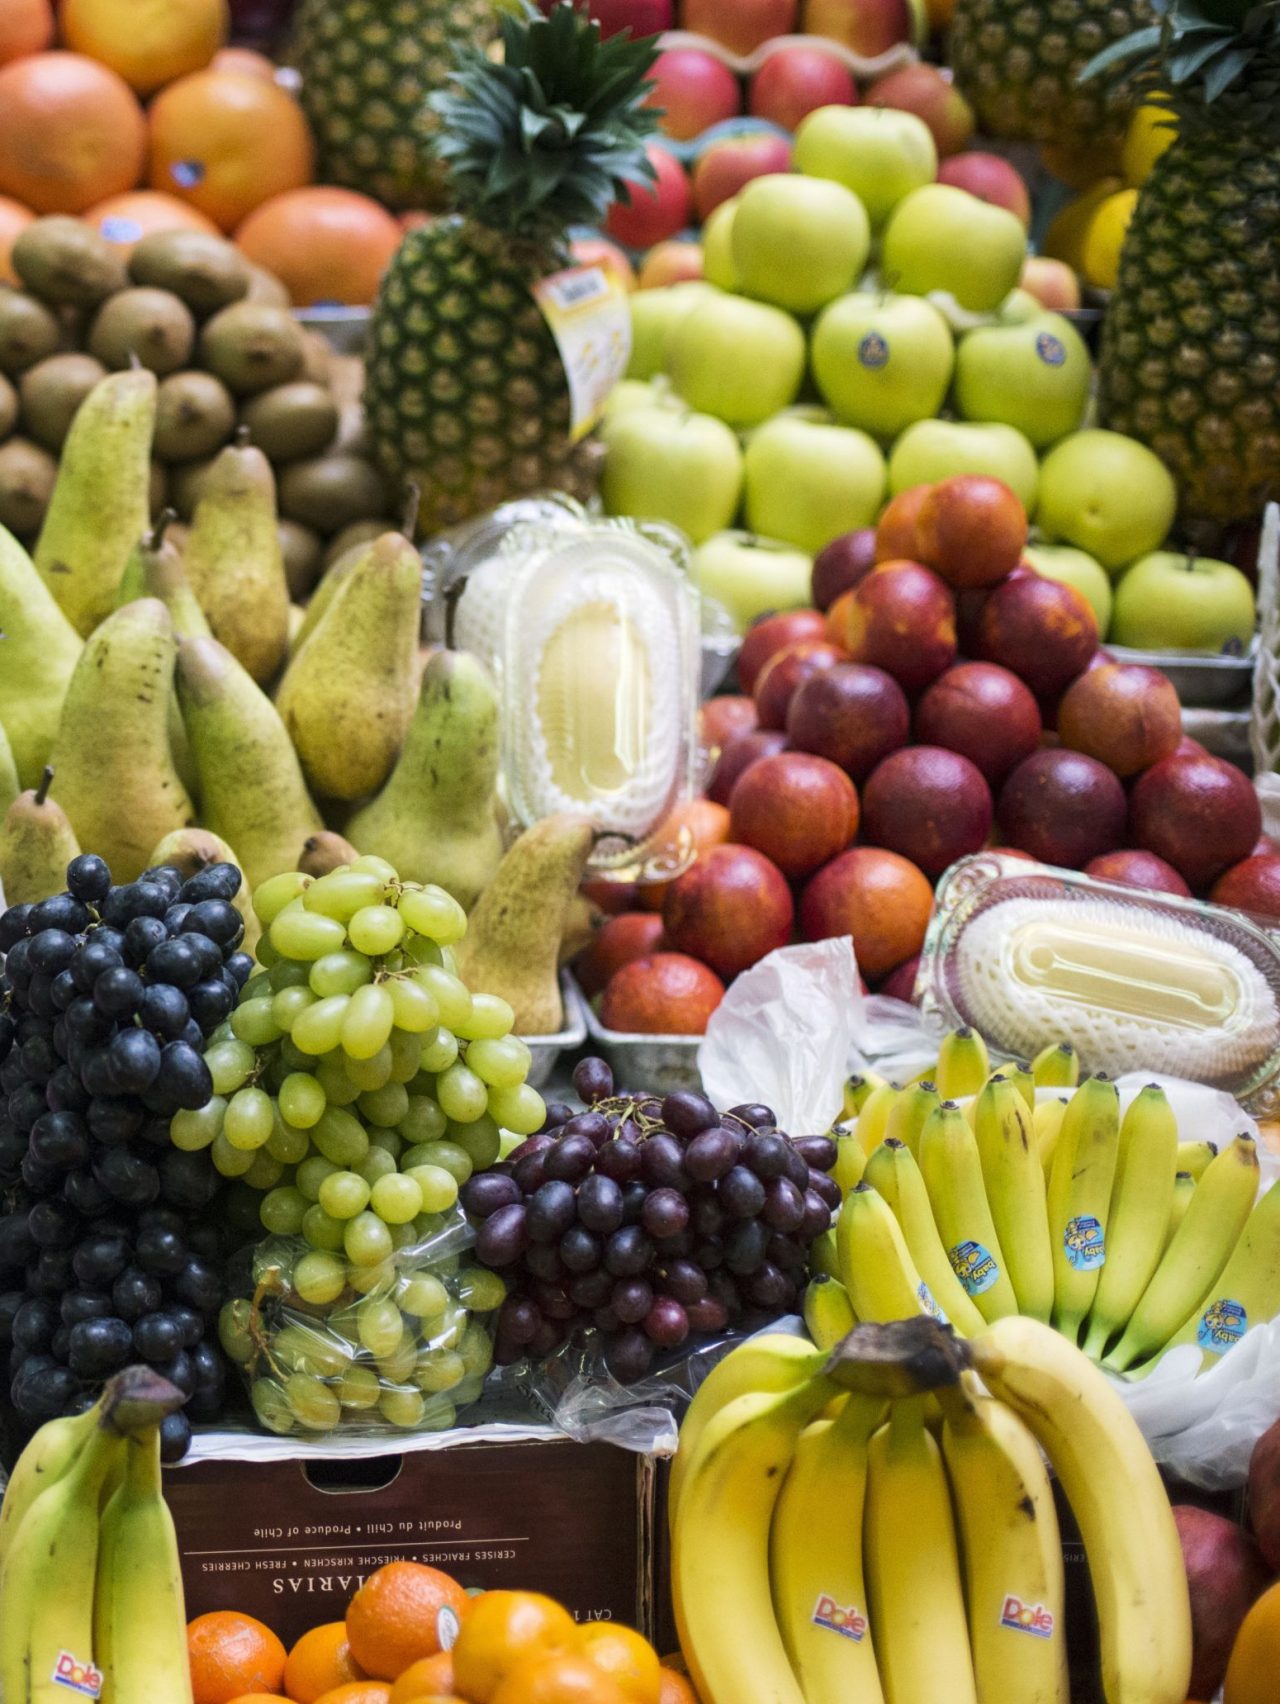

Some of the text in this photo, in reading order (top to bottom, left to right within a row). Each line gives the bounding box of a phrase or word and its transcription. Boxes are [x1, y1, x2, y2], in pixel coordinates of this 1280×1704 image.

[972, 1258, 997, 1280] baby
[253, 1519, 462, 1538] Produit du Chili Produce of Chile
[422, 1551, 470, 1562] FRAICHES
[475, 1550, 516, 1560] CERISES
[202, 1562, 251, 1572] CHERRIES
[255, 1559, 287, 1570] FRESH
[304, 1557, 353, 1568] KIRSCHEN
[585, 1608, 612, 1621] CAT
[816, 1596, 866, 1635] Dole
[1003, 1597, 1053, 1632] Dole
[57, 1654, 100, 1689] Dole
